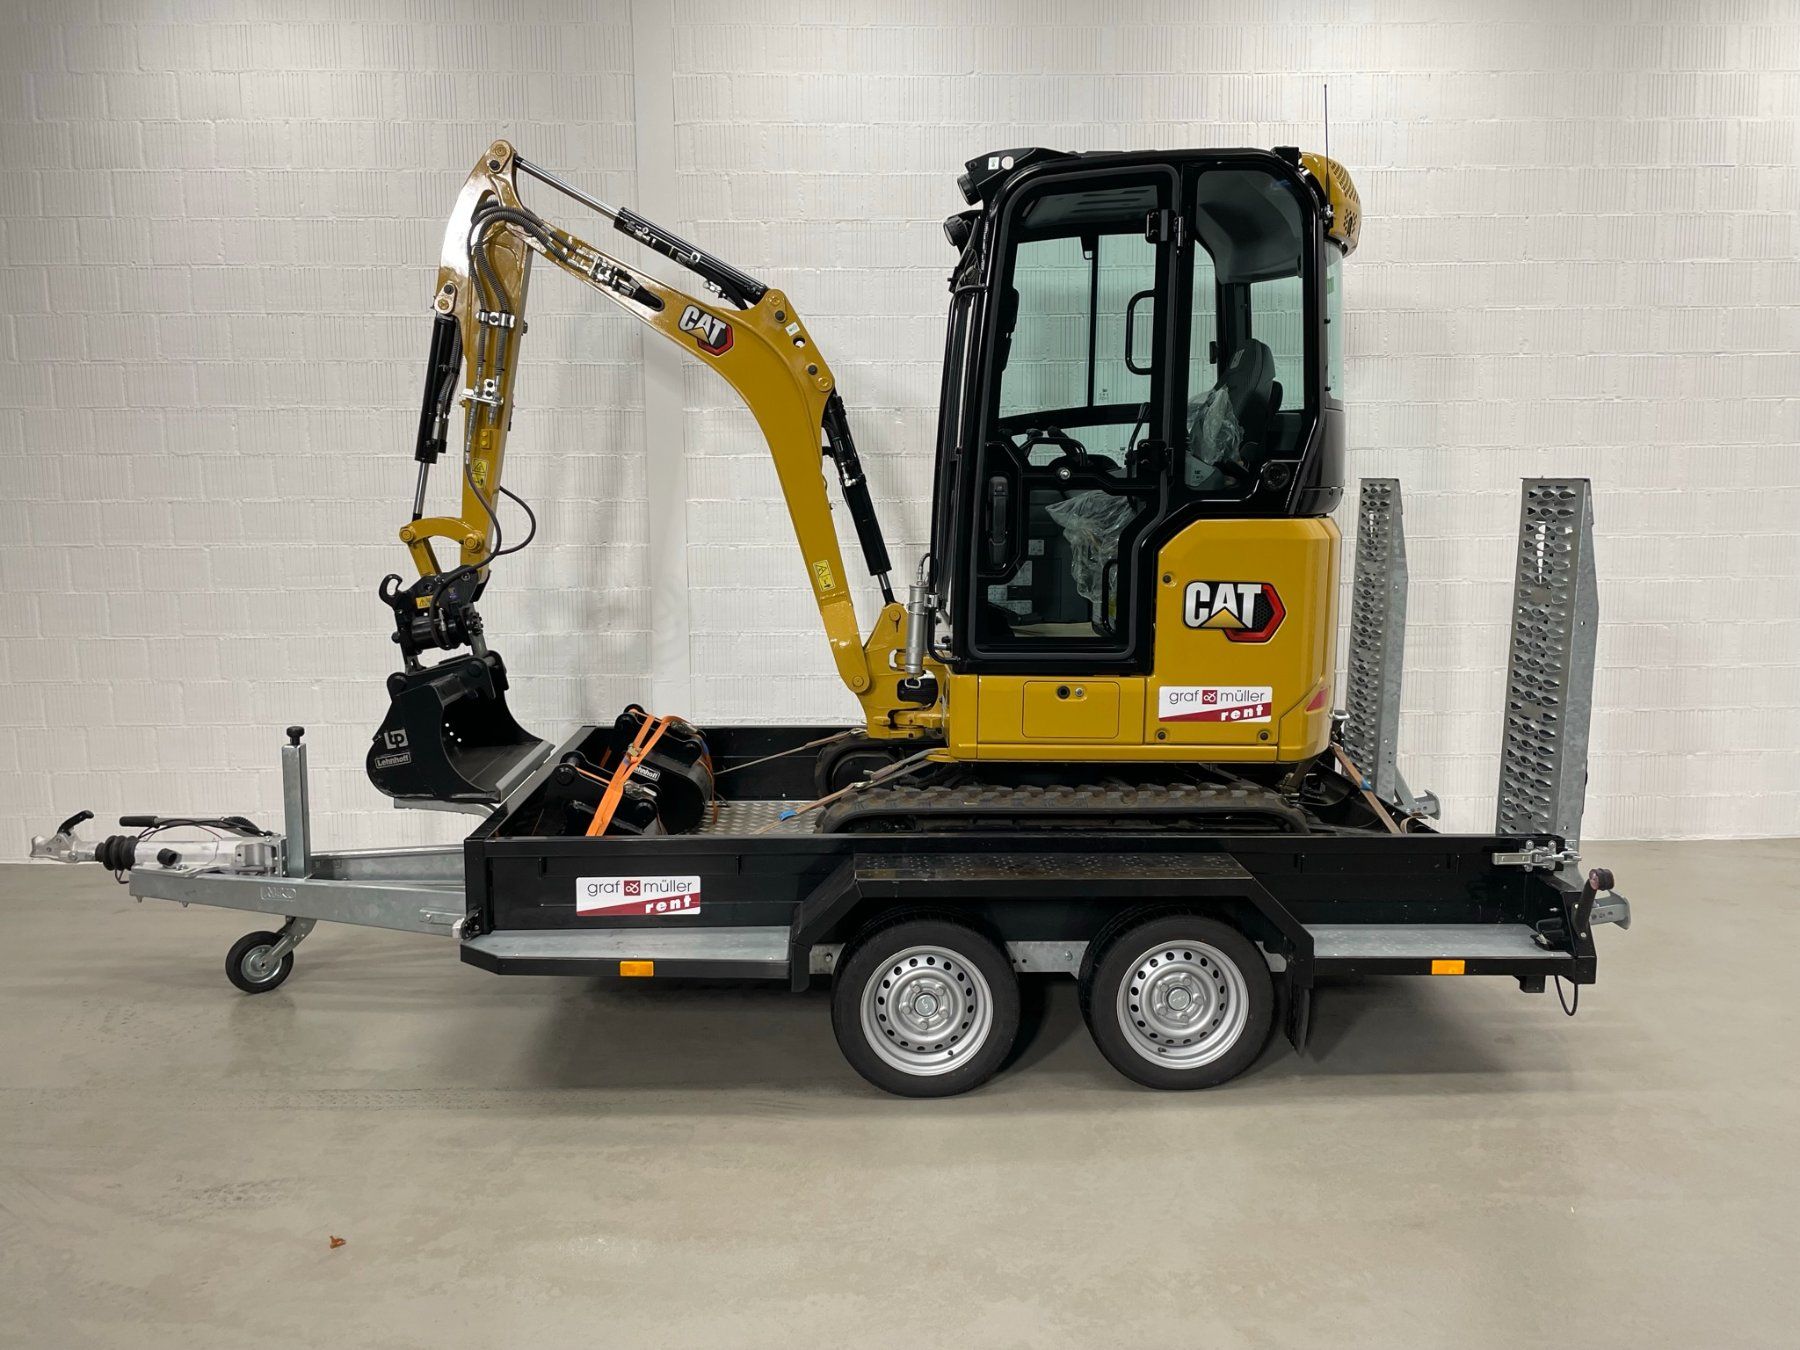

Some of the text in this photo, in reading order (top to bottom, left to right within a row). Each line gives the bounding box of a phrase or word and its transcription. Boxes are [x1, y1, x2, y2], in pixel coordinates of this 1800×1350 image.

[680, 305, 727, 346] CAT
[1184, 581, 1262, 629] CAT
[1169, 689, 1200, 705] graf
[1220, 689, 1265, 702] müller
[1220, 704, 1264, 721] rent
[376, 754, 410, 767] Lehnhoff
[587, 879, 621, 897] graf
[643, 879, 692, 893] müller
[645, 894, 692, 914] rent
